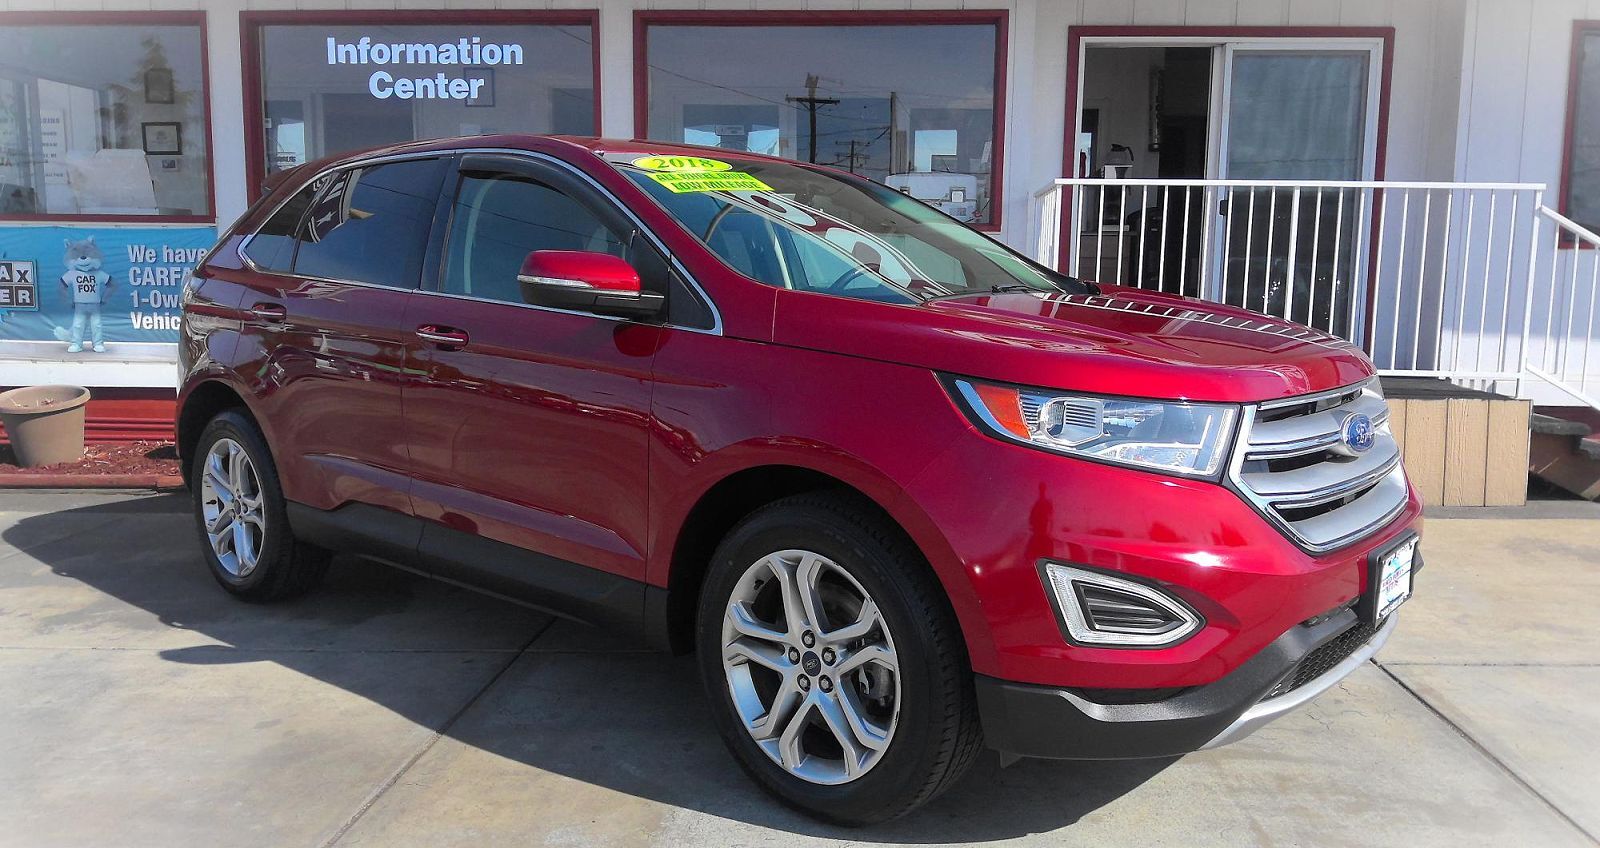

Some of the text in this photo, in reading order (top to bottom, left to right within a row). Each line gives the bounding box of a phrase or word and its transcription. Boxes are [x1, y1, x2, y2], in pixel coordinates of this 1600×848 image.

[326, 36, 524, 65] Information
[368, 70, 485, 99] Center
[653, 158, 714, 169] 2018
[655, 173, 753, 181] ALL WHEEL DRIVE
[671, 181, 762, 191] LOW MILEAGE
[127, 244, 208, 263] We have
[75, 275, 97, 284] CAR
[77, 284, 97, 294] FOX
